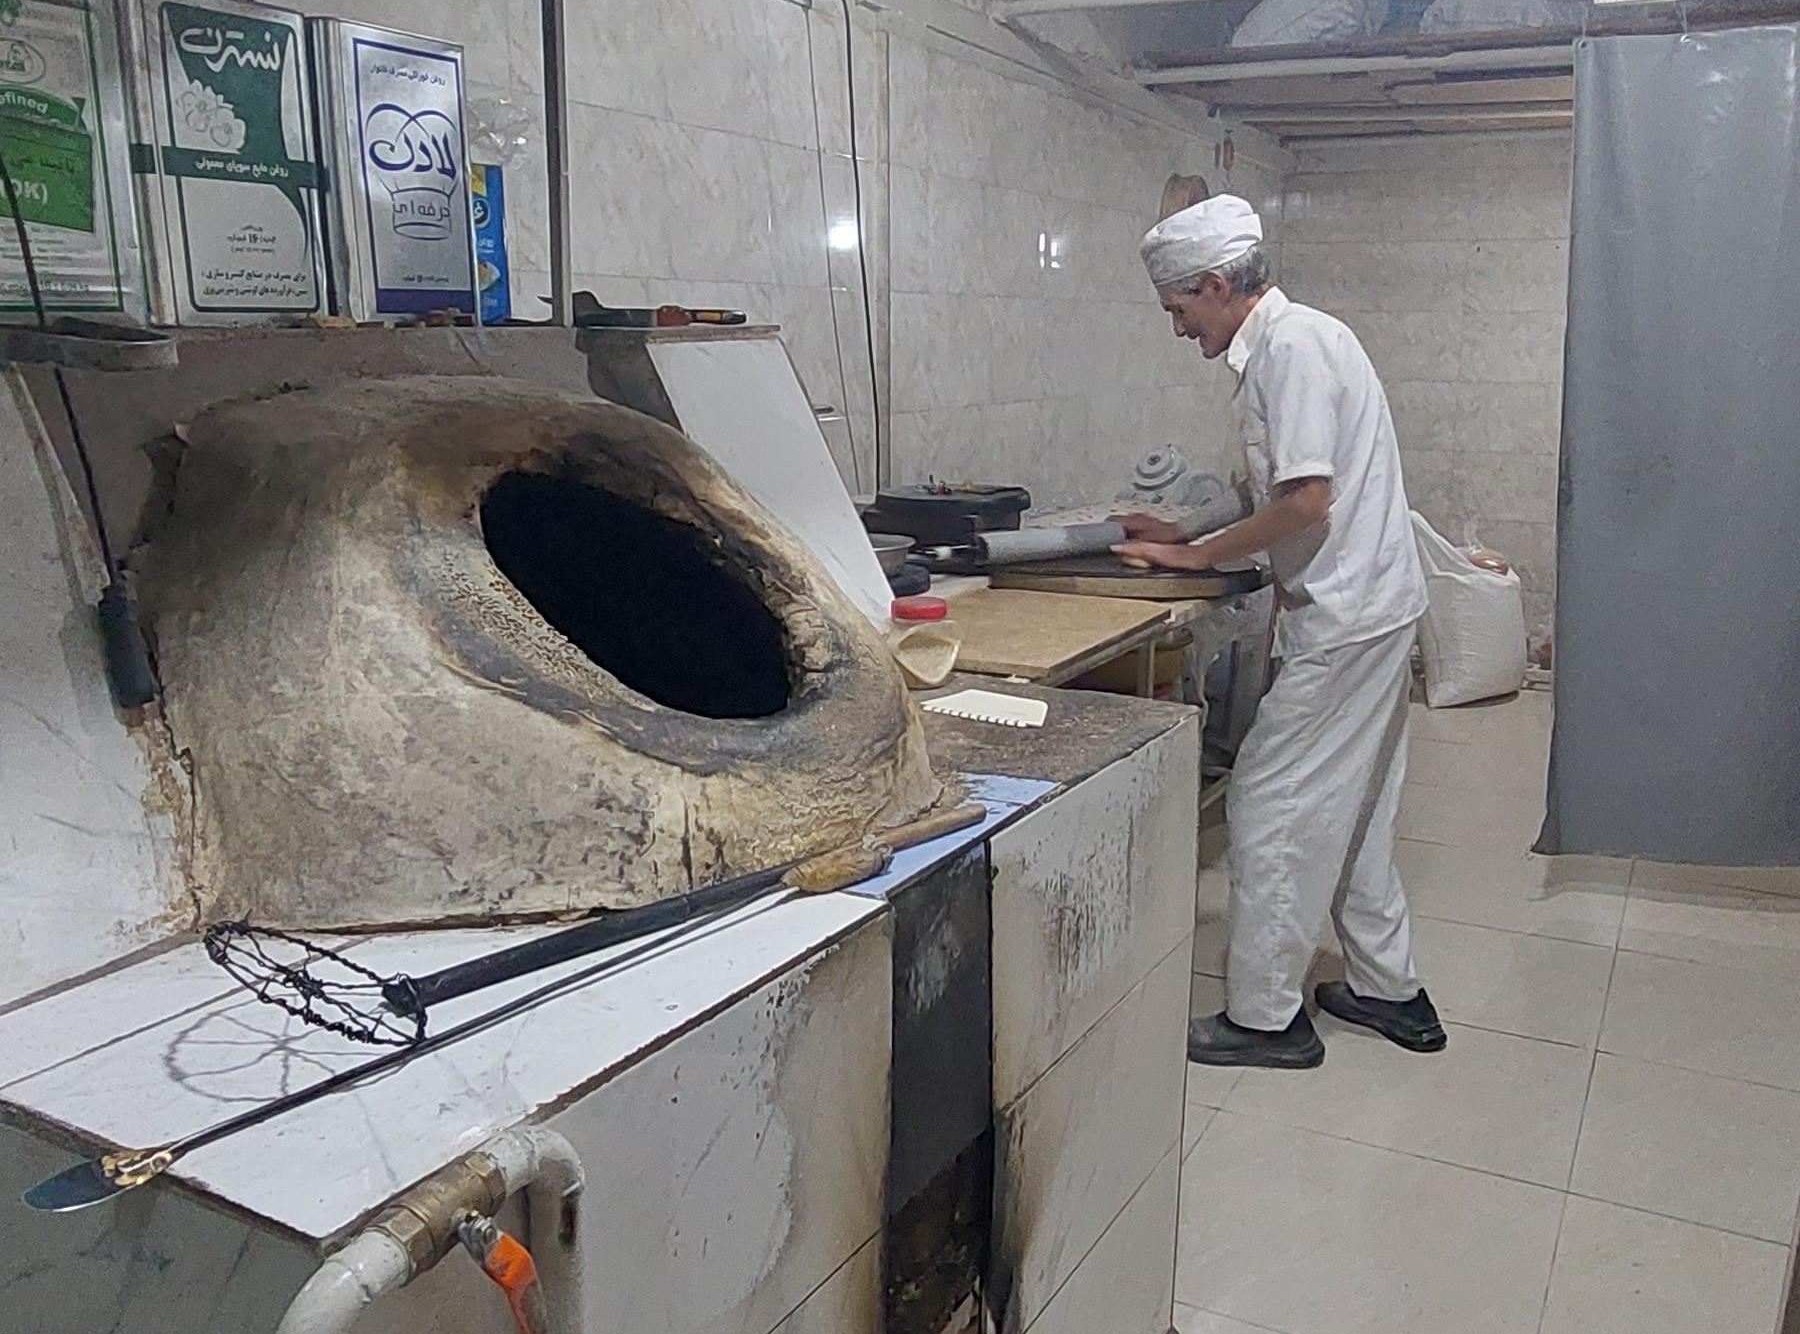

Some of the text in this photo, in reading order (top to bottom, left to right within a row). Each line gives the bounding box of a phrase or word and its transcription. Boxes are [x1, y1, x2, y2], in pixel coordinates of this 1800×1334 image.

[180, 27, 281, 73] نسترن
[0, 90, 49, 115] efined
[369, 132, 457, 181] لادن
